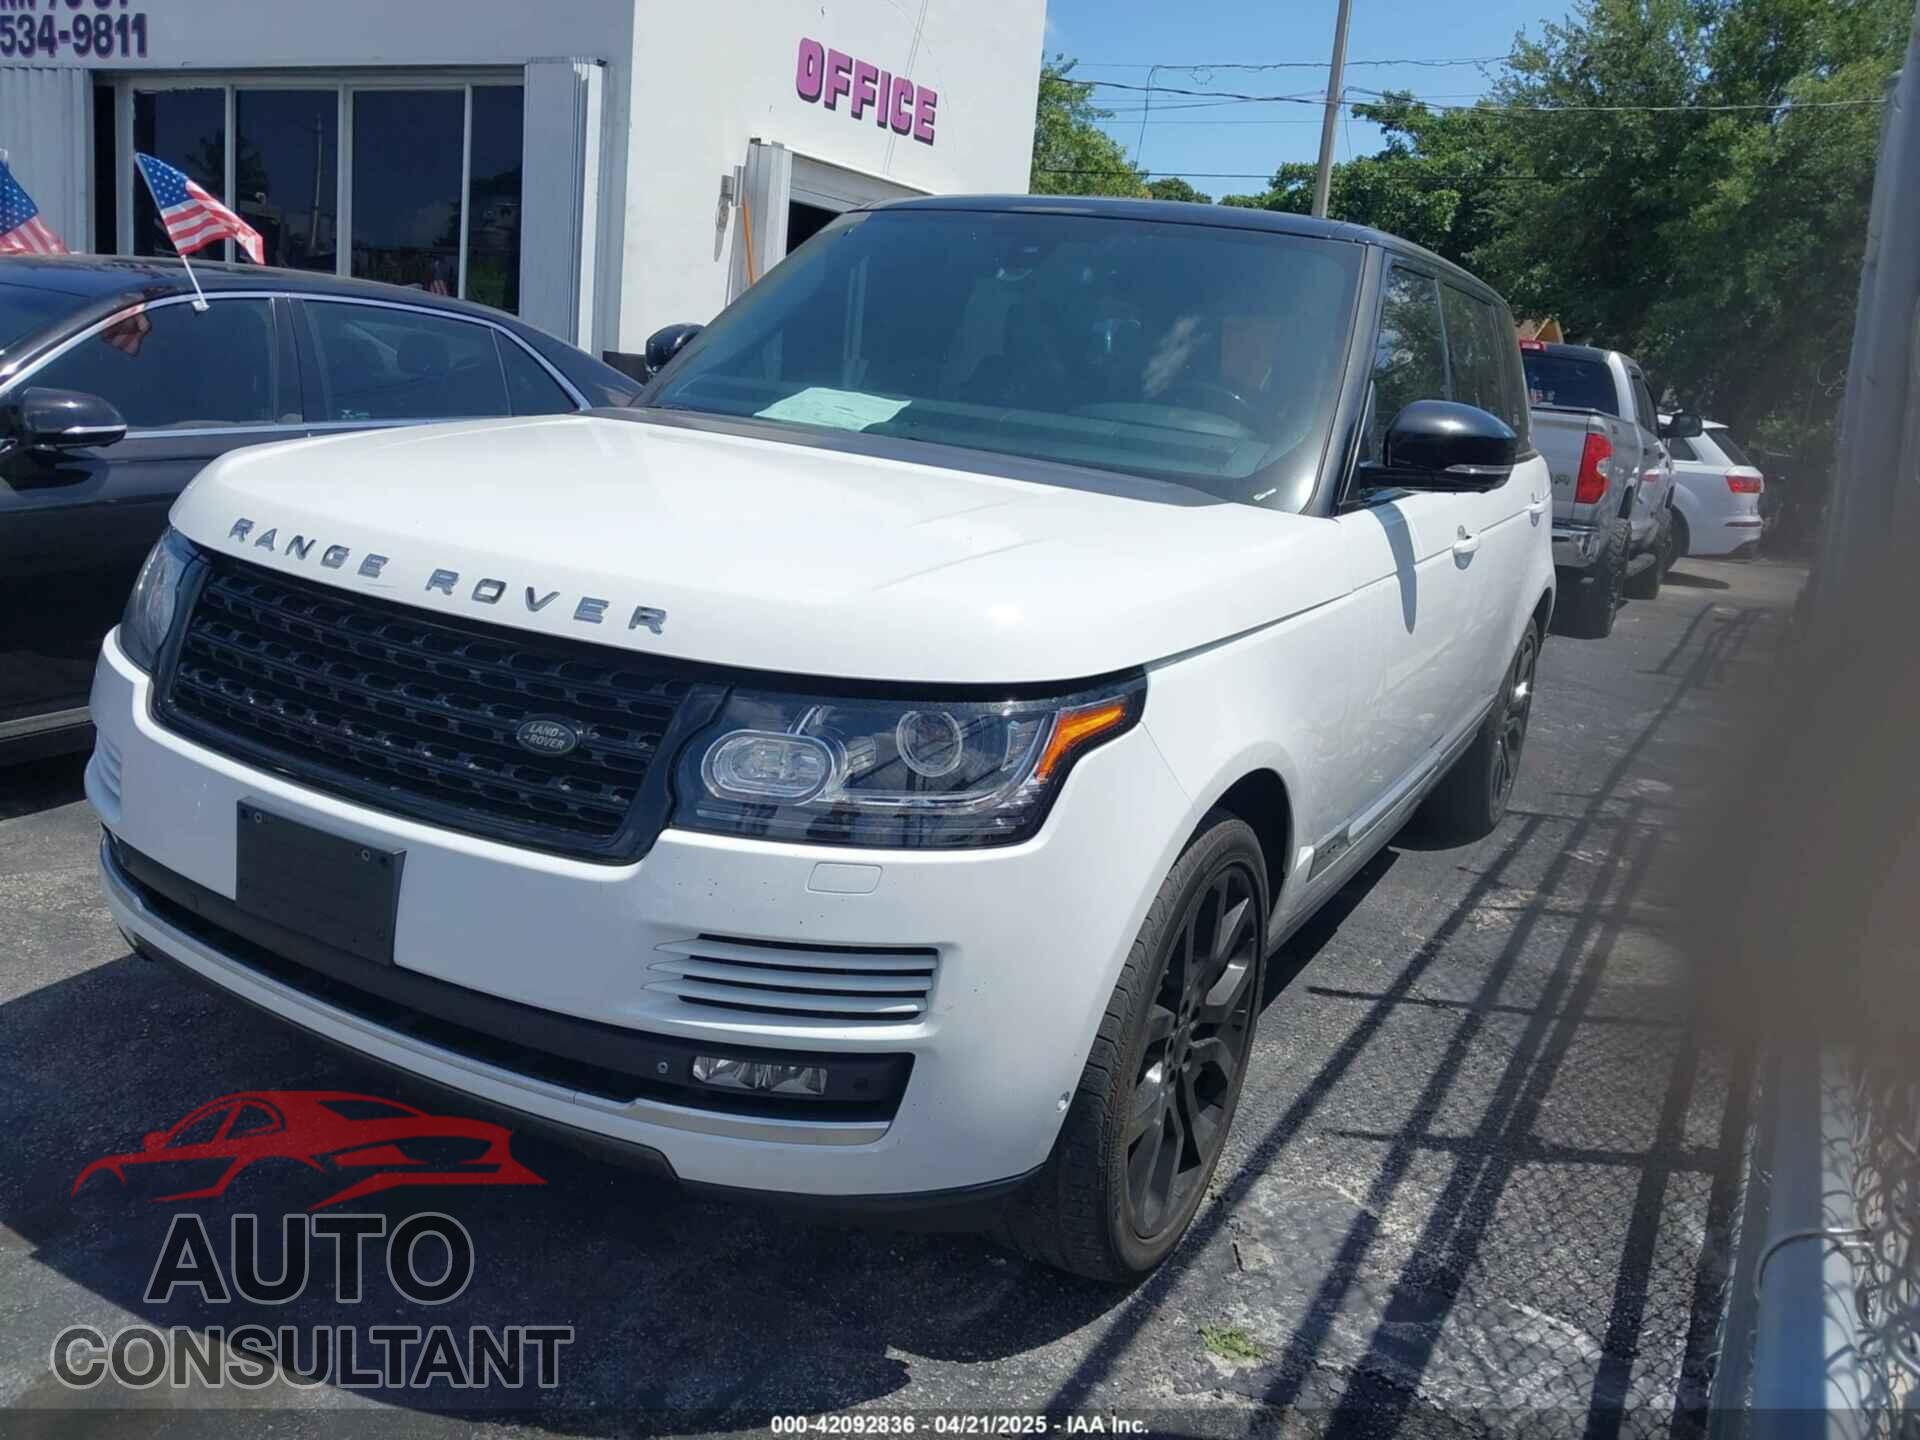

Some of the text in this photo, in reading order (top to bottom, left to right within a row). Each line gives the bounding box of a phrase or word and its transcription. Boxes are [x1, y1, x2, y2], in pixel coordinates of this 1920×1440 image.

[0, 13, 148, 58] 534-9811
[796, 37, 938, 146] OFFICE
[228, 517, 668, 635] RANGE ROVER
